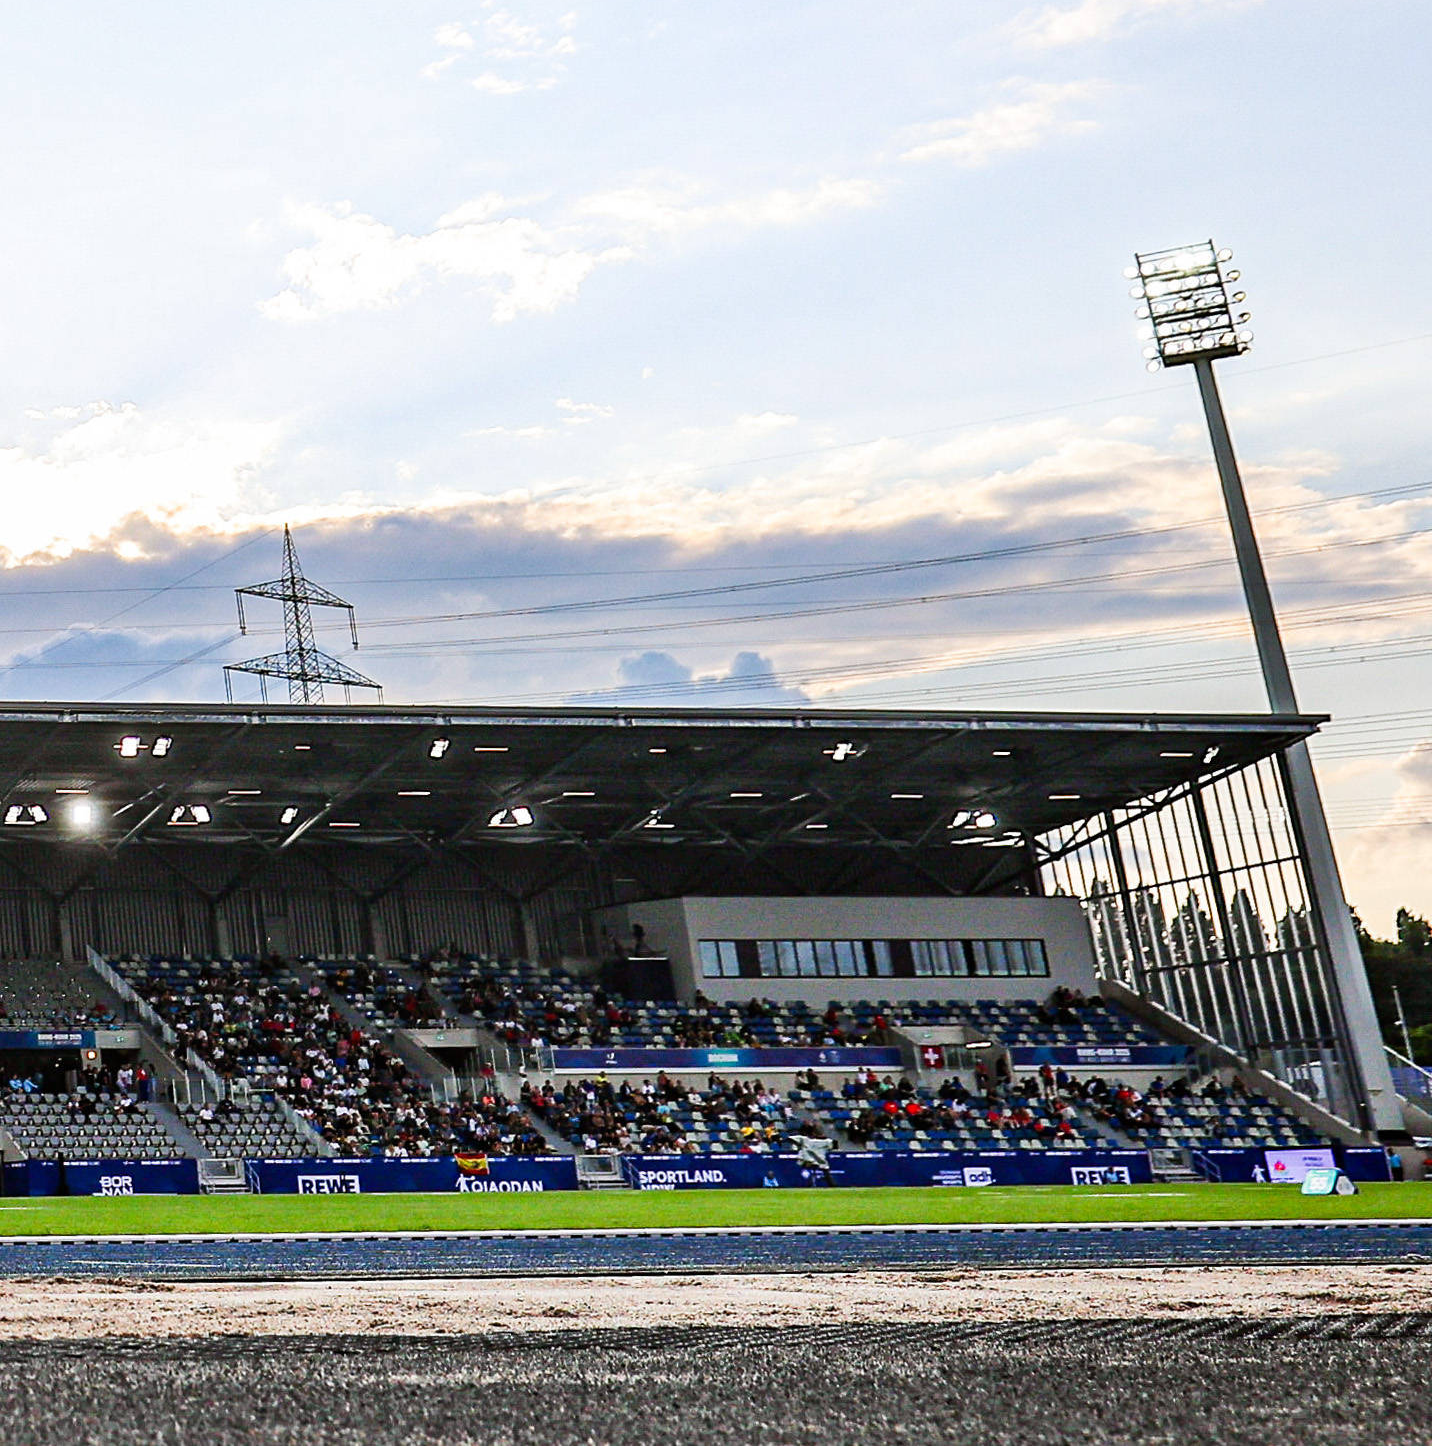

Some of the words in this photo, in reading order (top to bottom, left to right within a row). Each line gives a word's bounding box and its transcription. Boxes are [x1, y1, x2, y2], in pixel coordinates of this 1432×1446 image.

[100, 1176, 133, 1187] BOR
[639, 1170, 727, 1183] SPORTLAND.
[302, 1178, 357, 1194] REWE
[471, 1180, 544, 1193] QIAODAN
